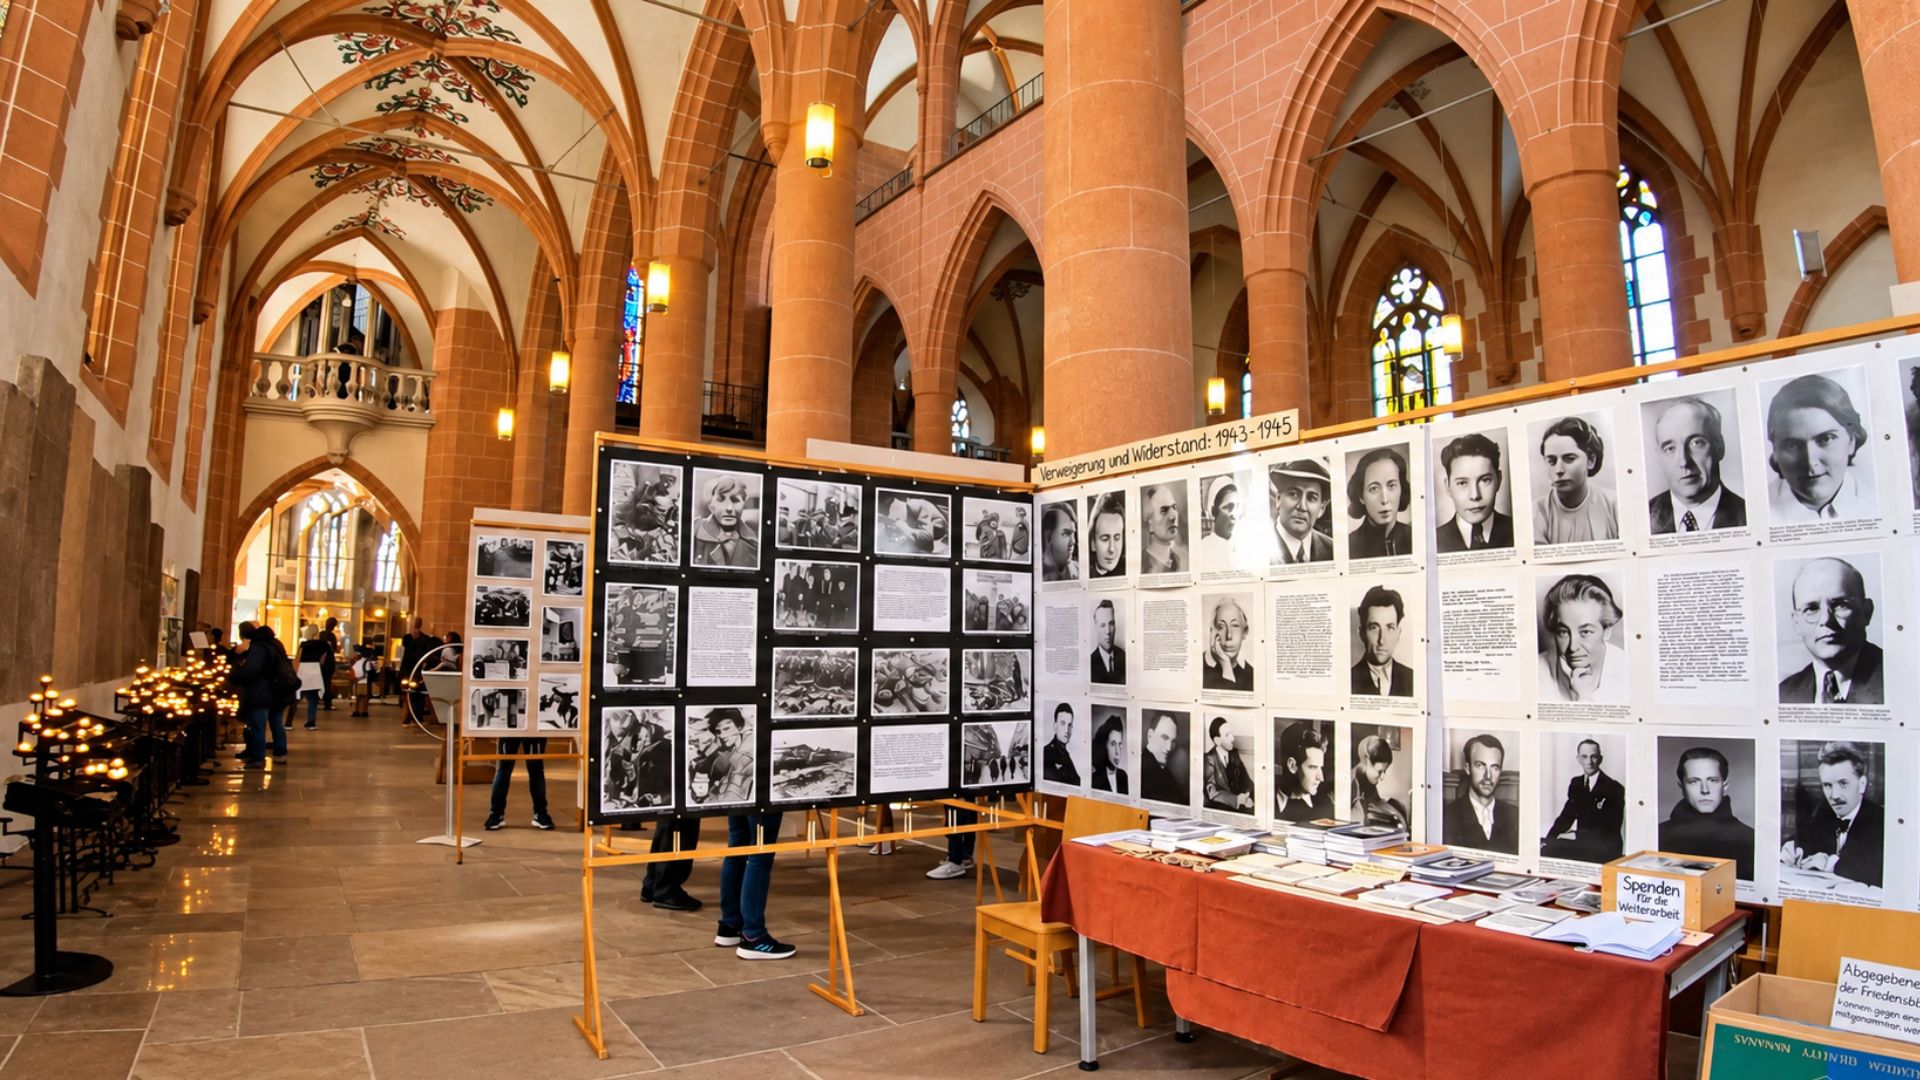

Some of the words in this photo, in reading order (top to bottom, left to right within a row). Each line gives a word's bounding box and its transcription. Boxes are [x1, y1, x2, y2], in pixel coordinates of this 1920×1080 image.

[1040, 458, 1106, 481] Verweigerung
[1109, 448, 1130, 468] und
[1132, 432, 1212, 463] Widerstand:
[1623, 875, 1680, 898] Spenden
[1654, 895, 1669, 907] die
[1842, 962, 1920, 990] Abgegebene
[1839, 982, 1858, 994] der
